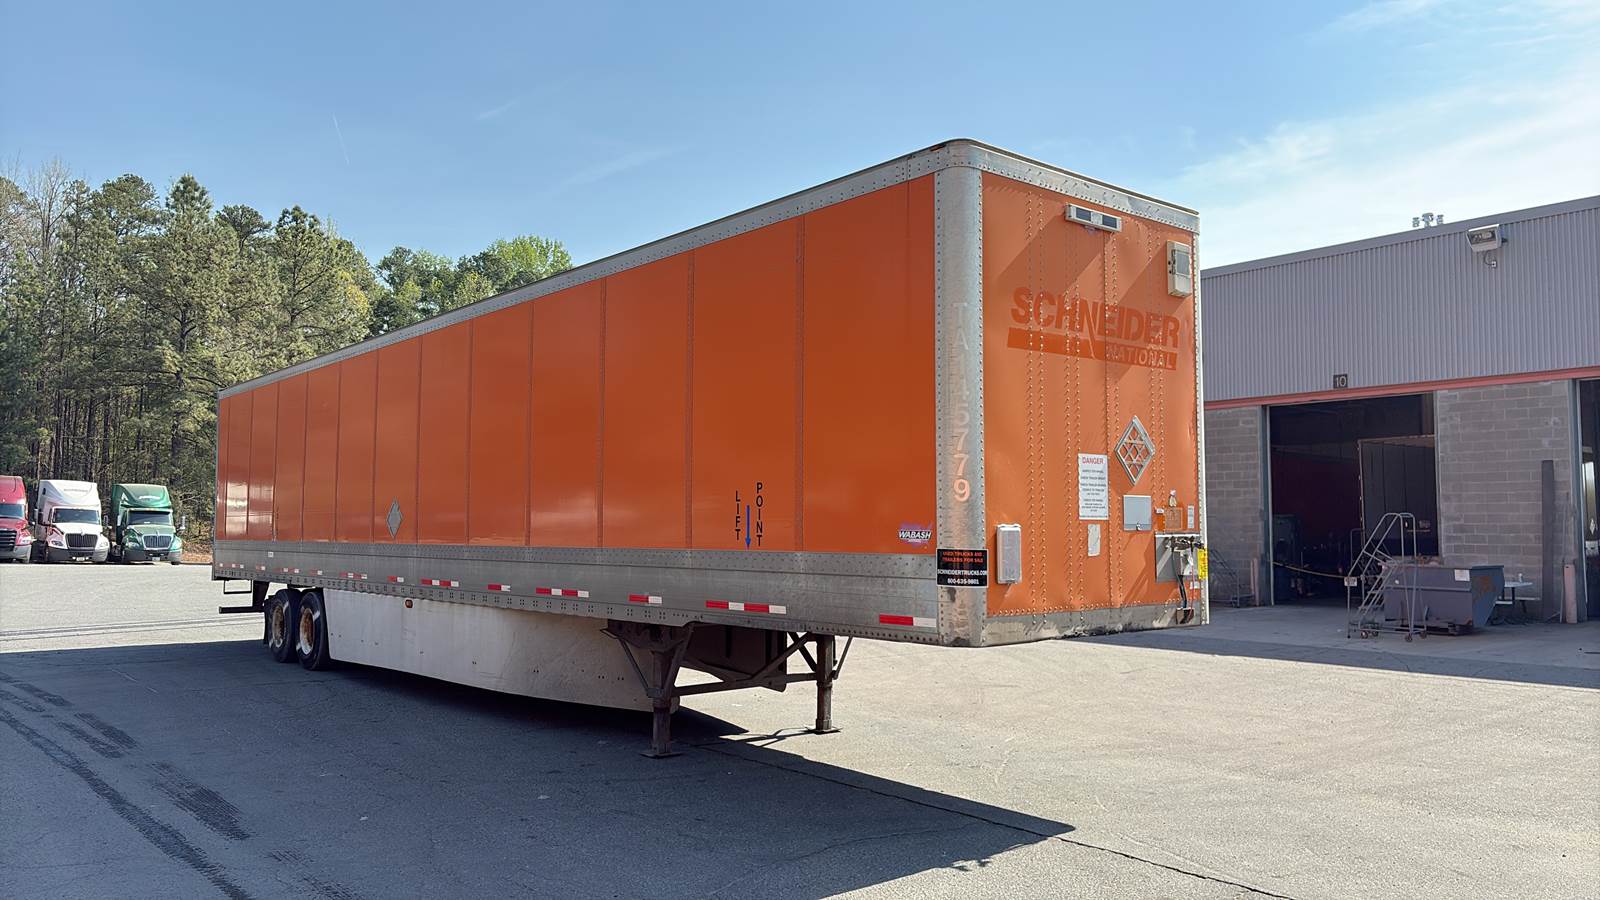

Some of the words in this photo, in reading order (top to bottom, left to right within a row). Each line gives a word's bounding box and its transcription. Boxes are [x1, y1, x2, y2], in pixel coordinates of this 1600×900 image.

[1011, 287, 1180, 348] SCHNEIDER
[1106, 346, 1173, 368] NATIONAL
[1336, 375, 1347, 387] 10
[1082, 457, 1104, 465] DANGER
[898, 530, 932, 540] WABASH
